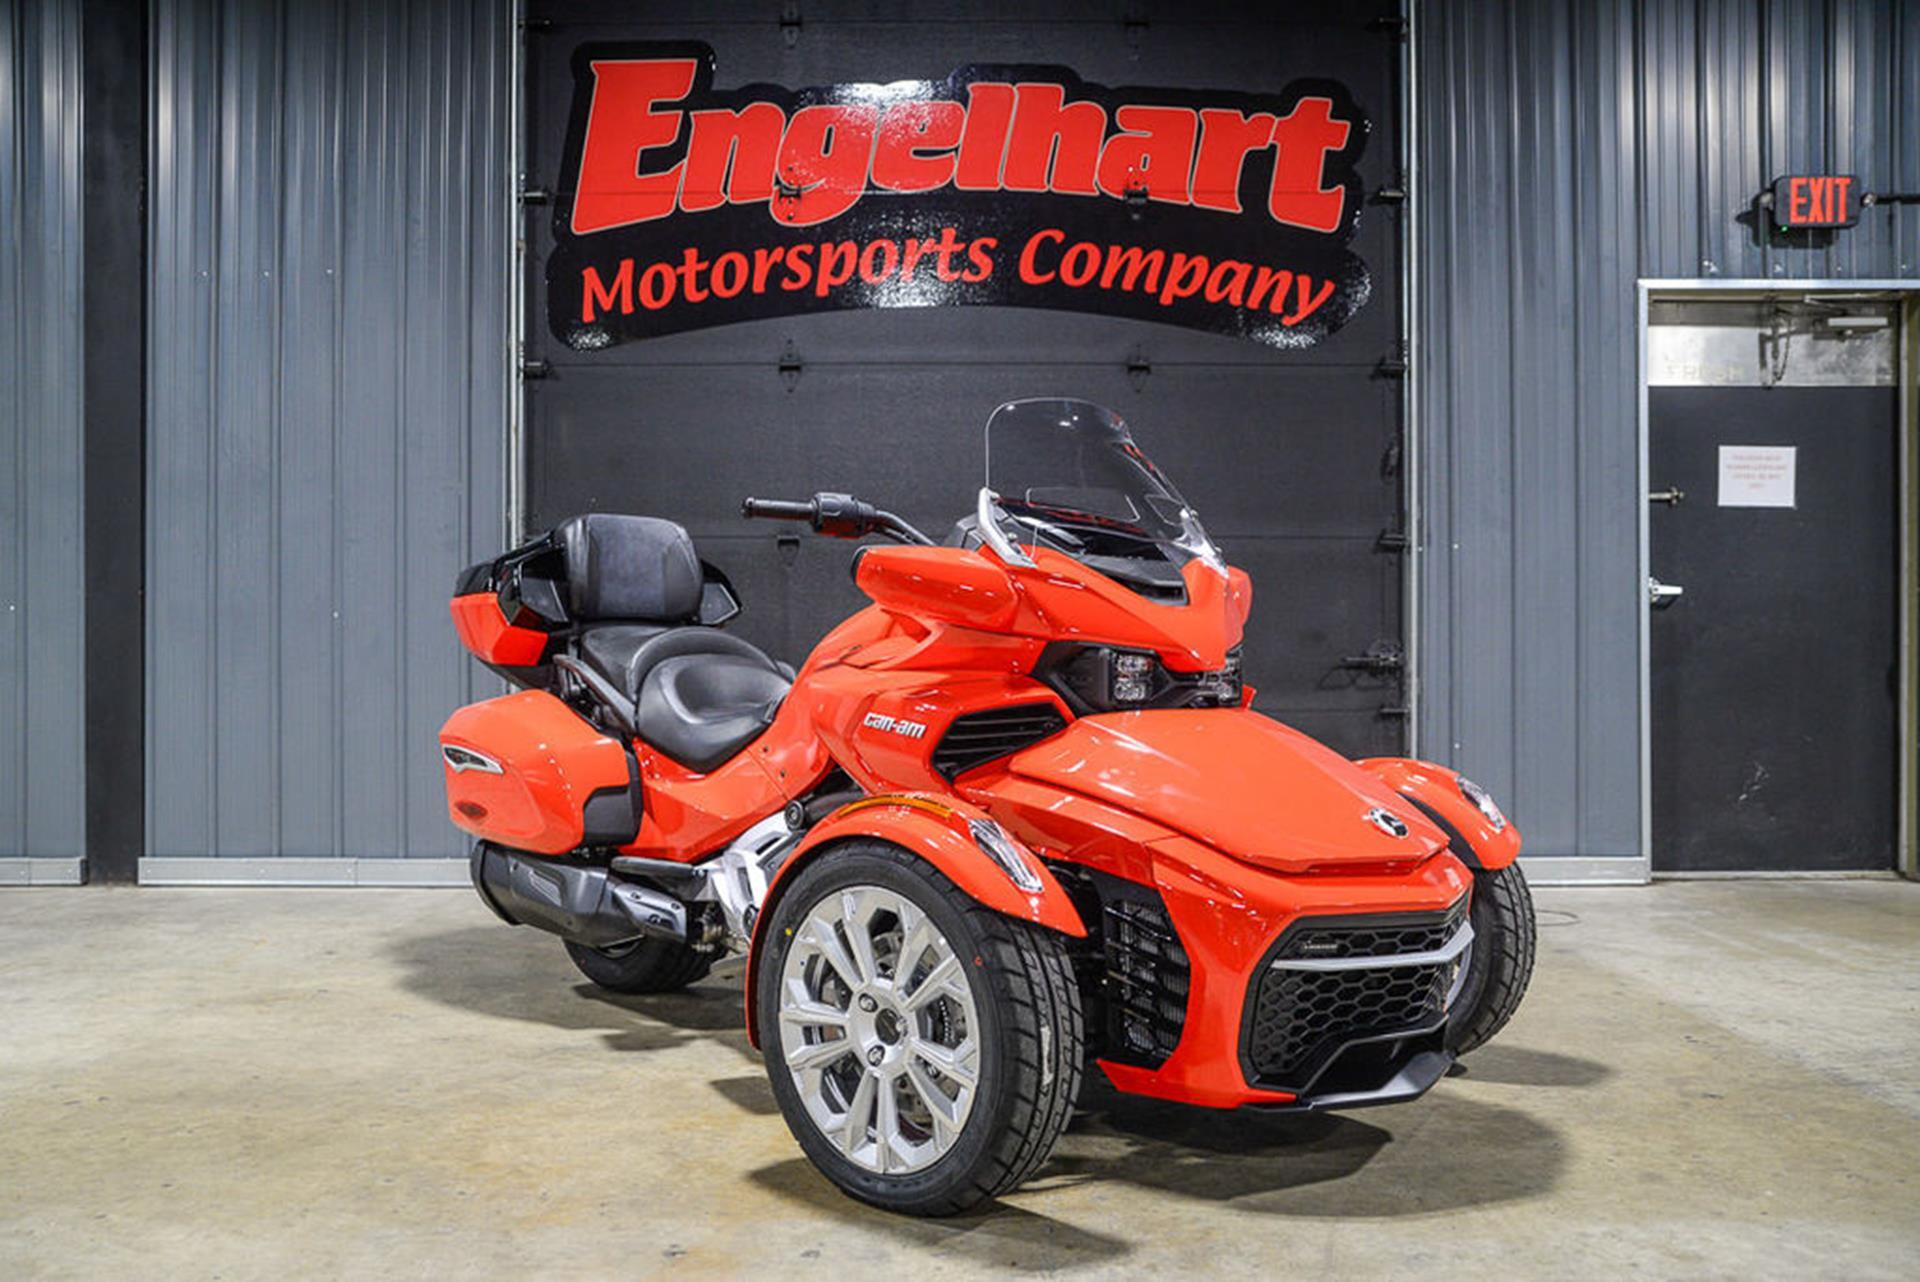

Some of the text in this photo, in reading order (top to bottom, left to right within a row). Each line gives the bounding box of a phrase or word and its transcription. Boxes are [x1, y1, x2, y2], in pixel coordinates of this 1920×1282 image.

[571, 59, 1351, 233] Engelhart
[1789, 176, 1852, 224] EXIT
[582, 227, 1335, 327] Motorsports Company
